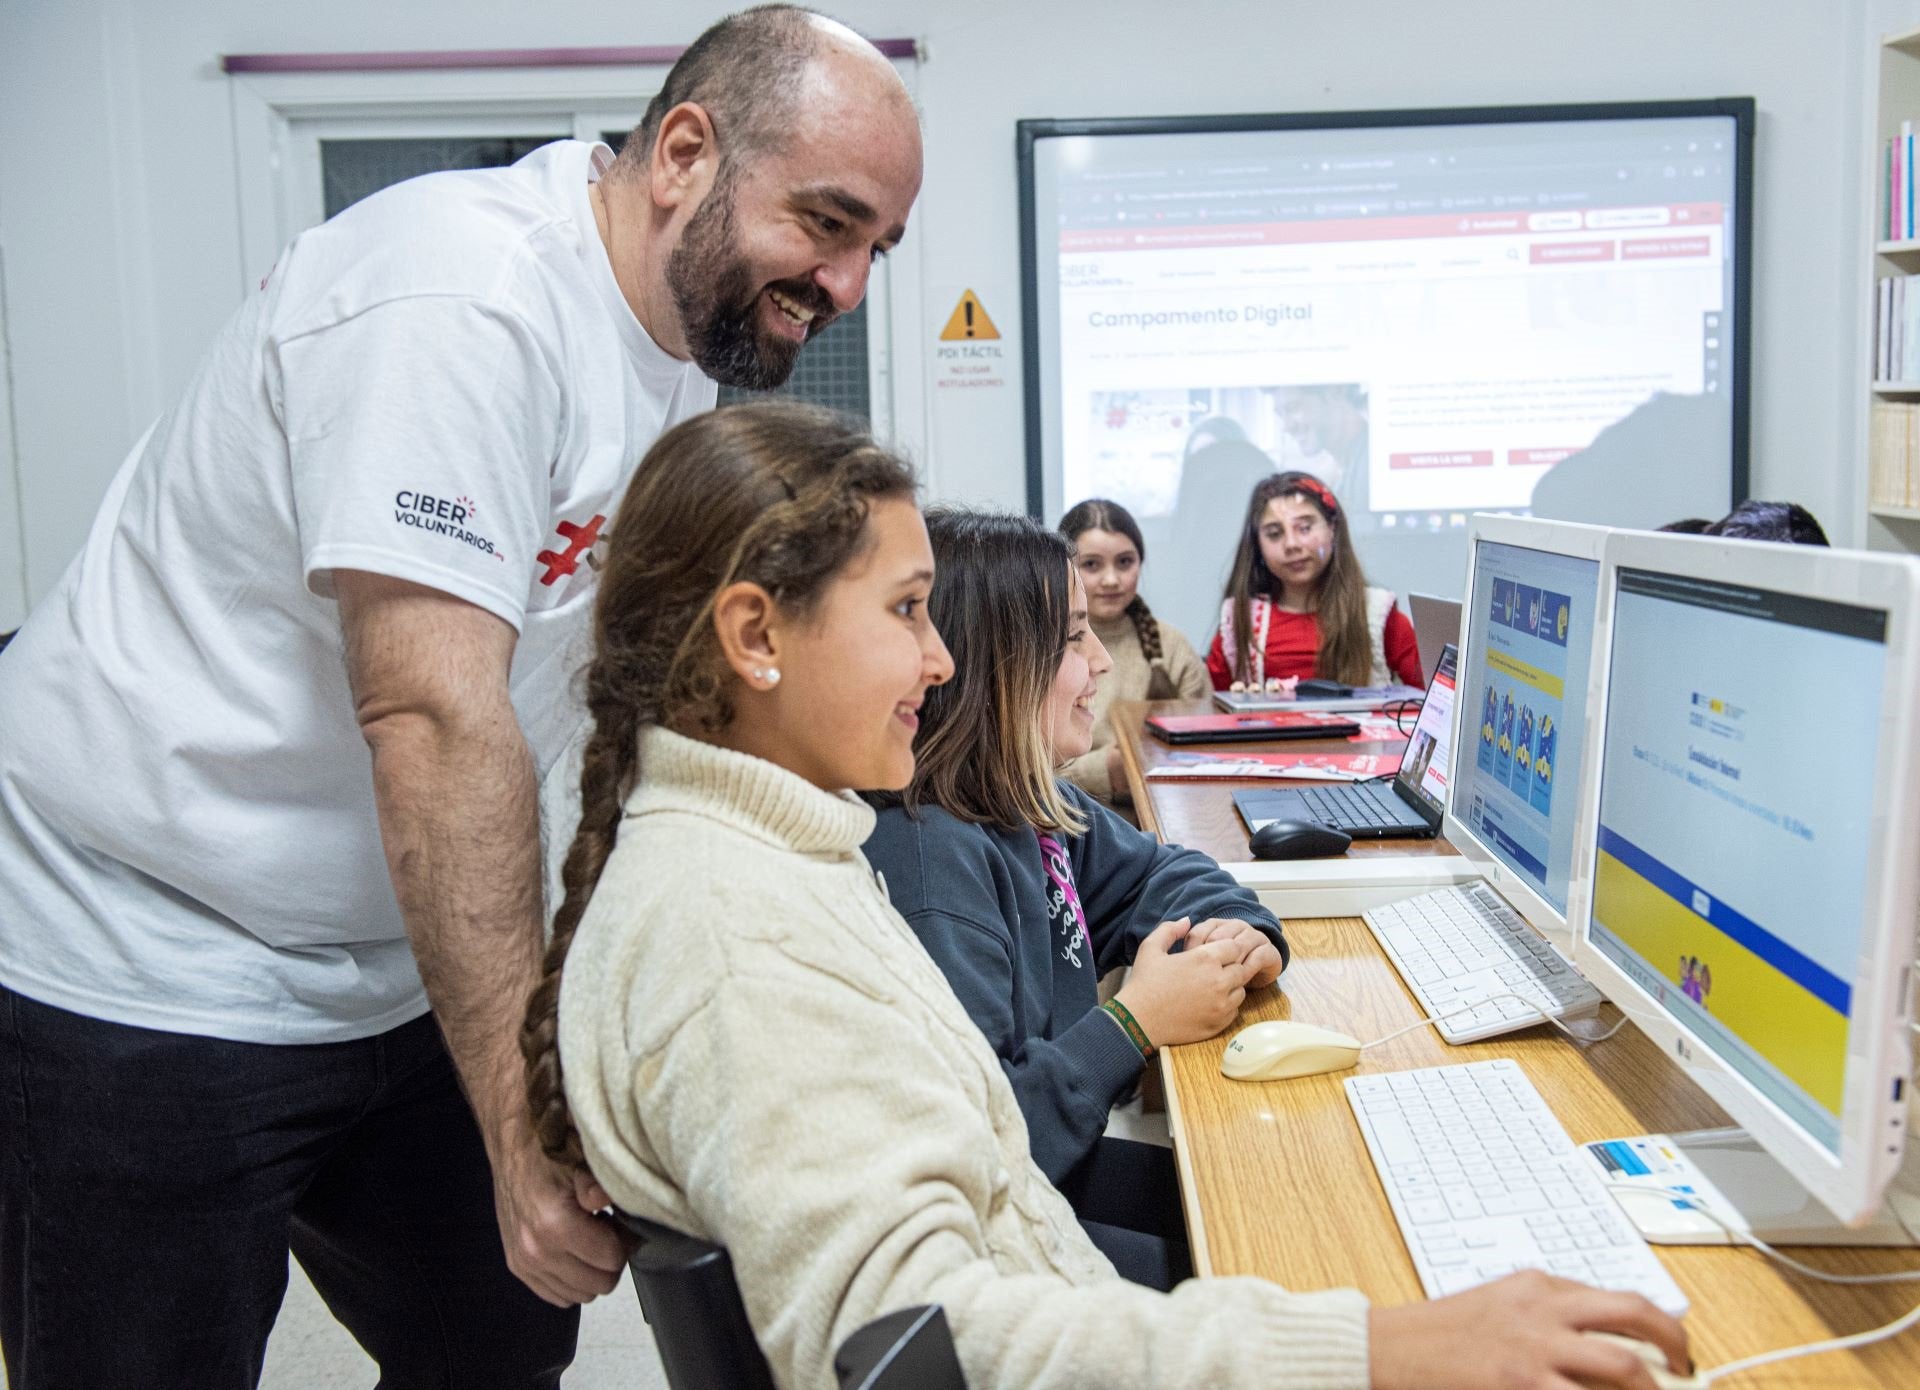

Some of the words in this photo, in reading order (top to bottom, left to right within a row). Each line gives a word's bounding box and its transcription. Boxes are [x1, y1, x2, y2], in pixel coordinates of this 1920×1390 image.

[1088, 307, 1239, 331] Campamento
[1244, 303, 1313, 327] Digital
[962, 345, 1003, 359] TÁCTIL
[396, 490, 467, 525] CIBER
